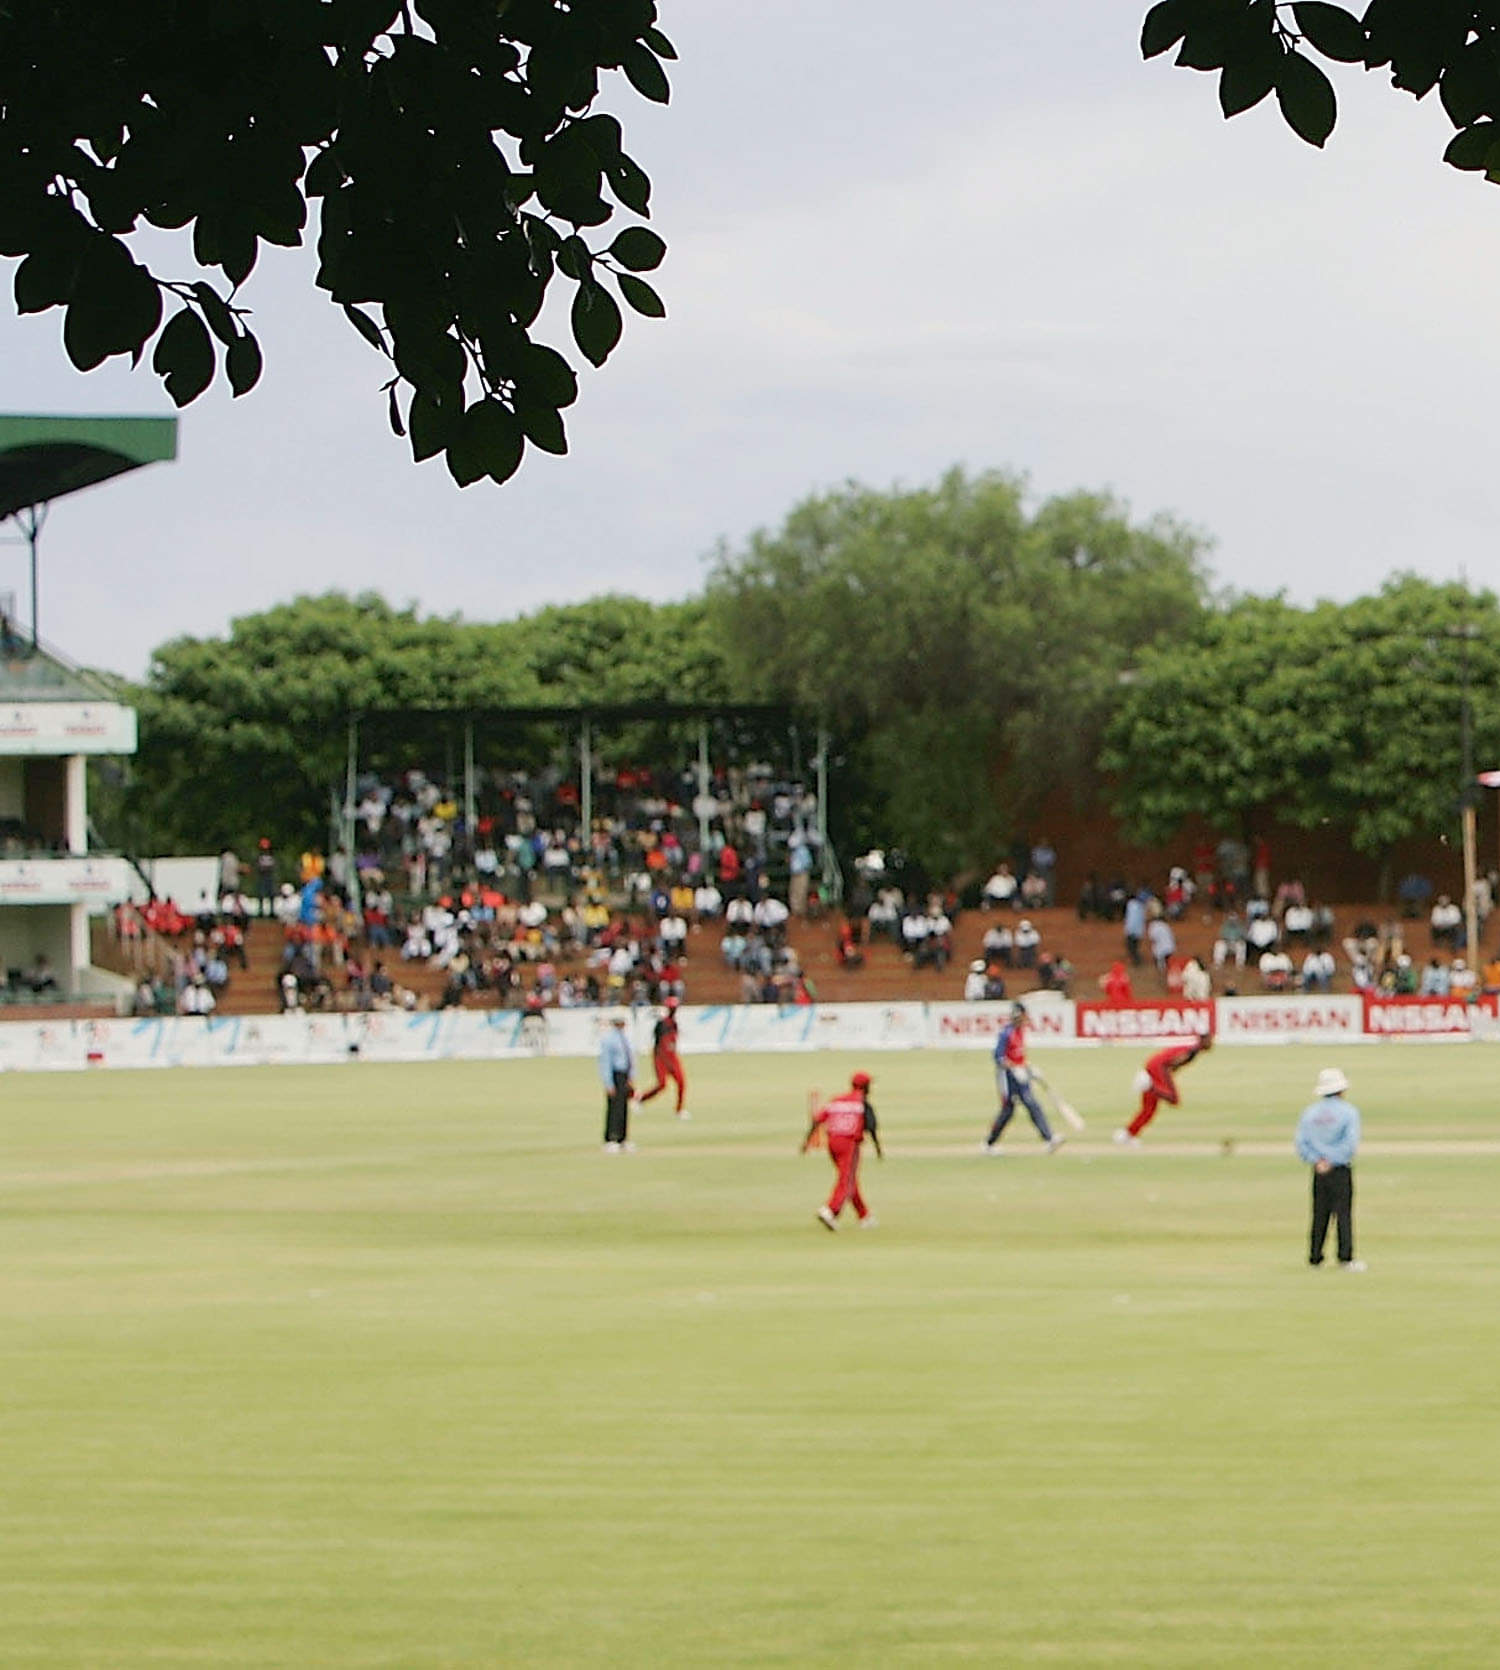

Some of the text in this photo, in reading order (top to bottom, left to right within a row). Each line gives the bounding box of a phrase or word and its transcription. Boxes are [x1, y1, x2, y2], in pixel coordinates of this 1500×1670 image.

[940, 1013, 1063, 1034] NISN
[1082, 1009, 1209, 1035] NISSAN
[1230, 1008, 1350, 1030] NISSAN
[1368, 1004, 1494, 1032] NISSAN
